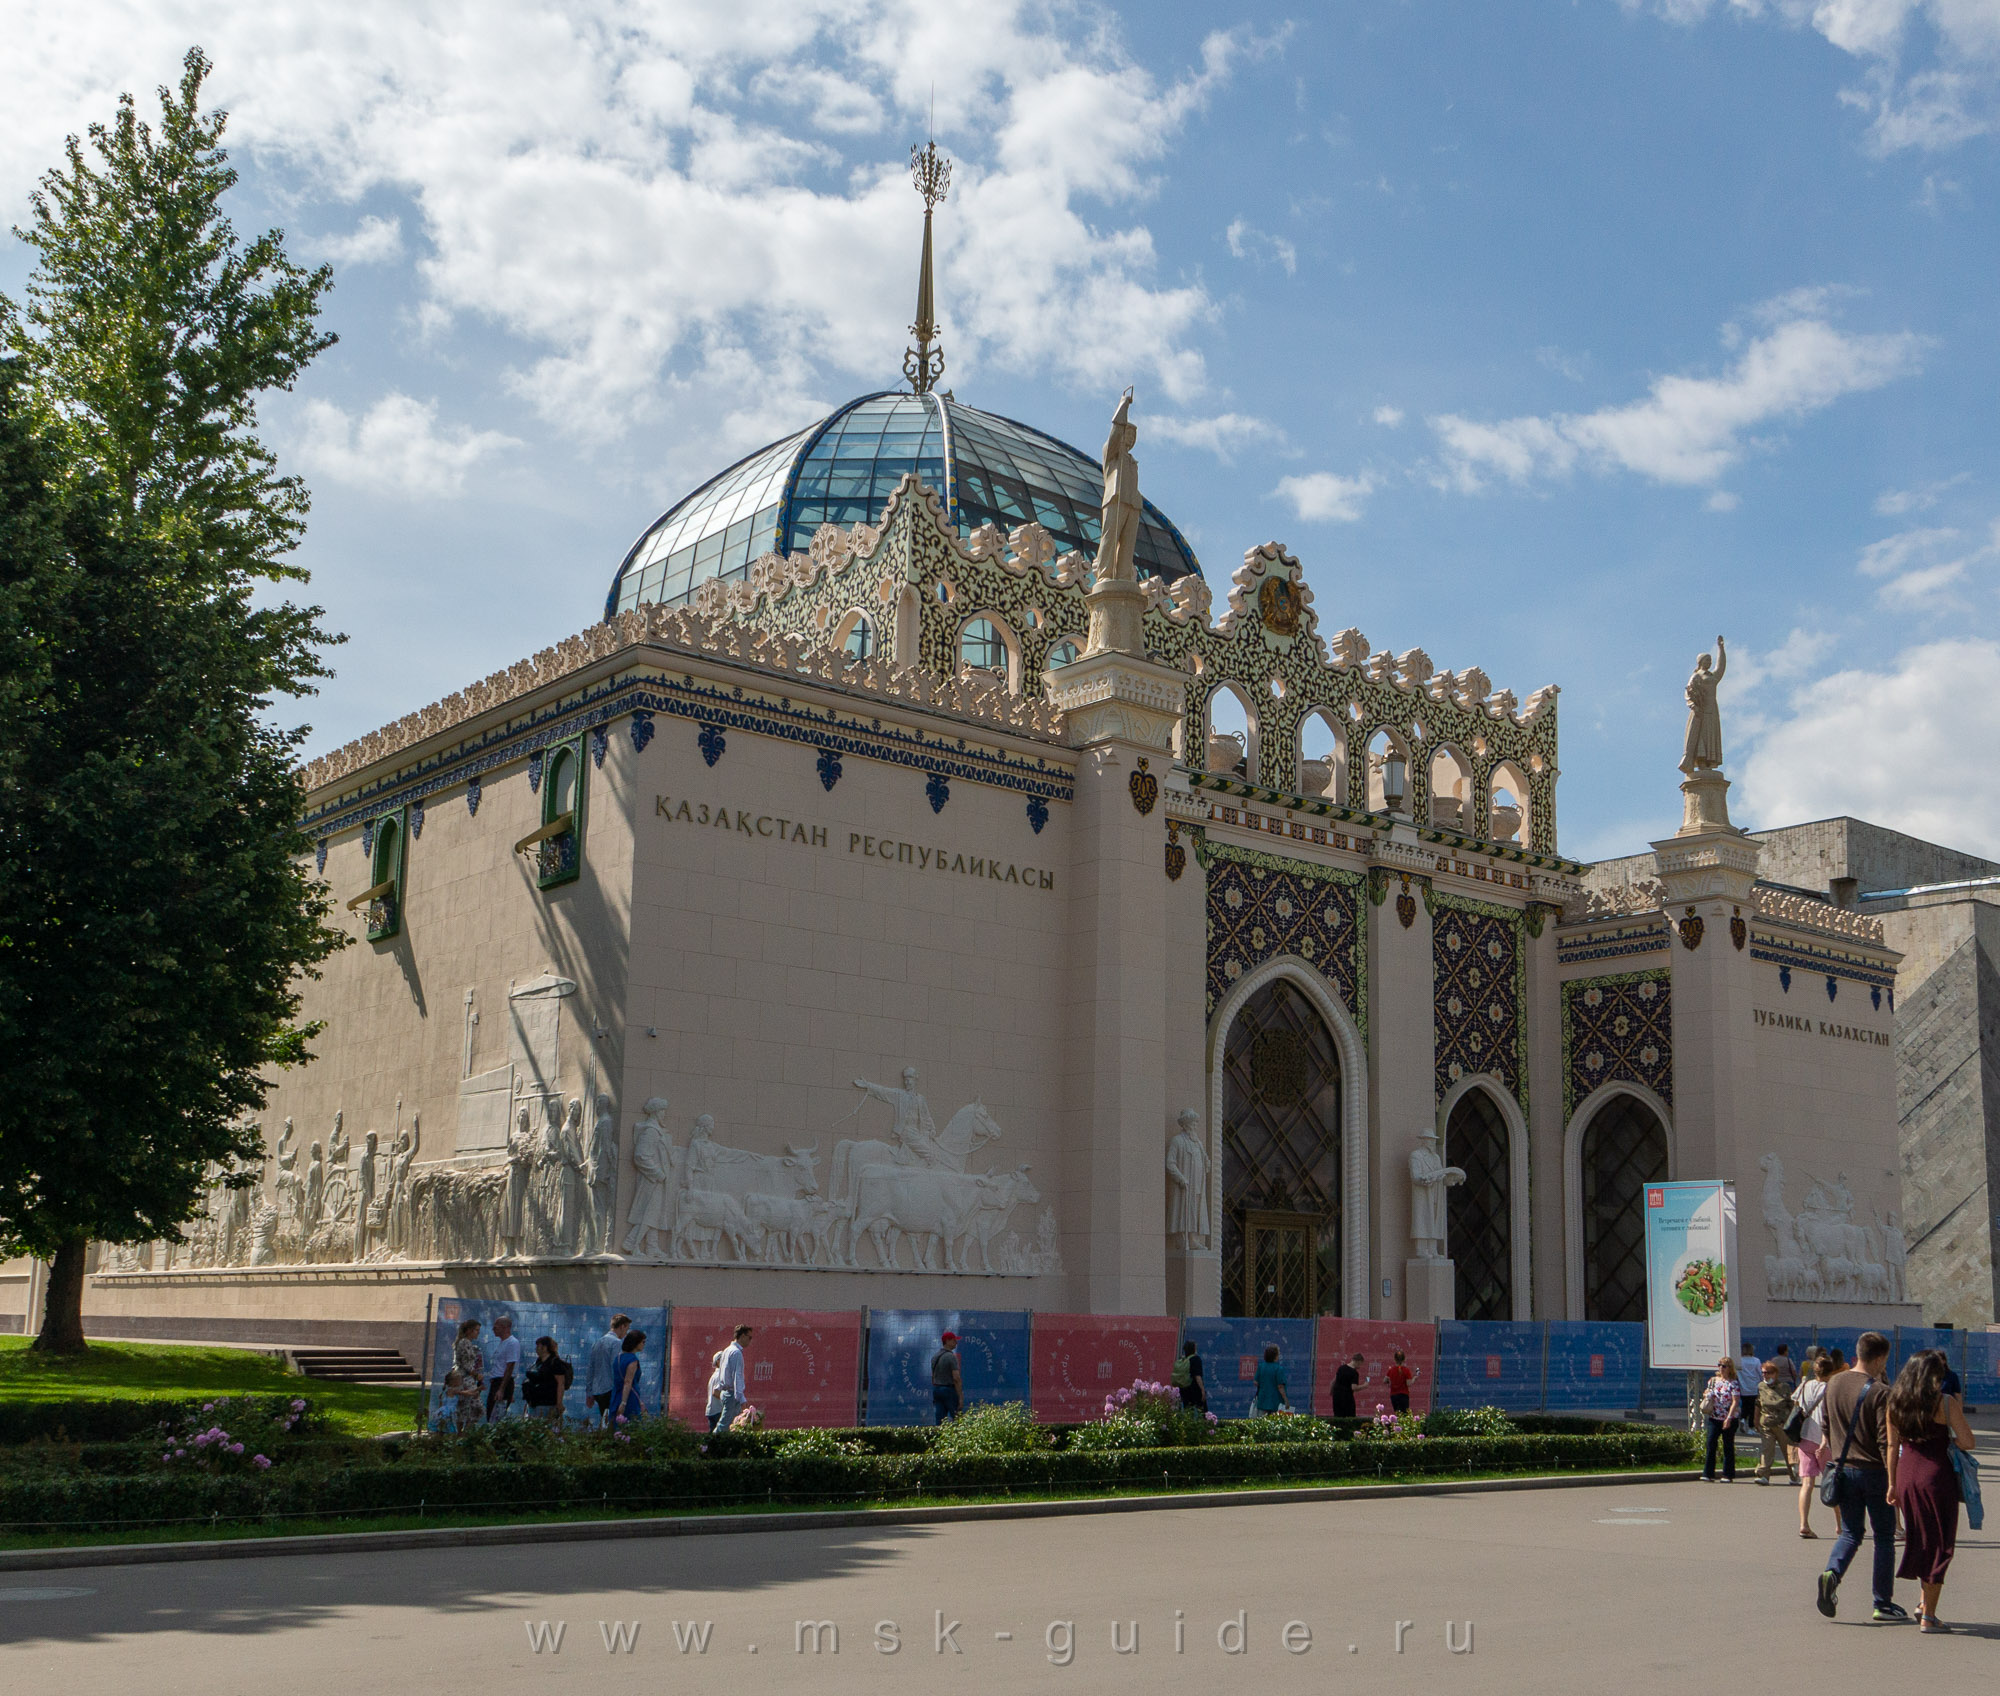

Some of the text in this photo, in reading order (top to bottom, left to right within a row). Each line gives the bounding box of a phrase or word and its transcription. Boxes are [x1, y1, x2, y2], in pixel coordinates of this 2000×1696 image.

[655, 794, 1055, 891] ҚАЗАҚСТАН РЕСПУБЛИКАСЫ
[1819, 1021, 1889, 1047] КАЗАХСТАН
[783, 1336, 816, 1375] прогулки
[965, 1335, 993, 1372] прогулки
[901, 1352, 929, 1397] приятной
